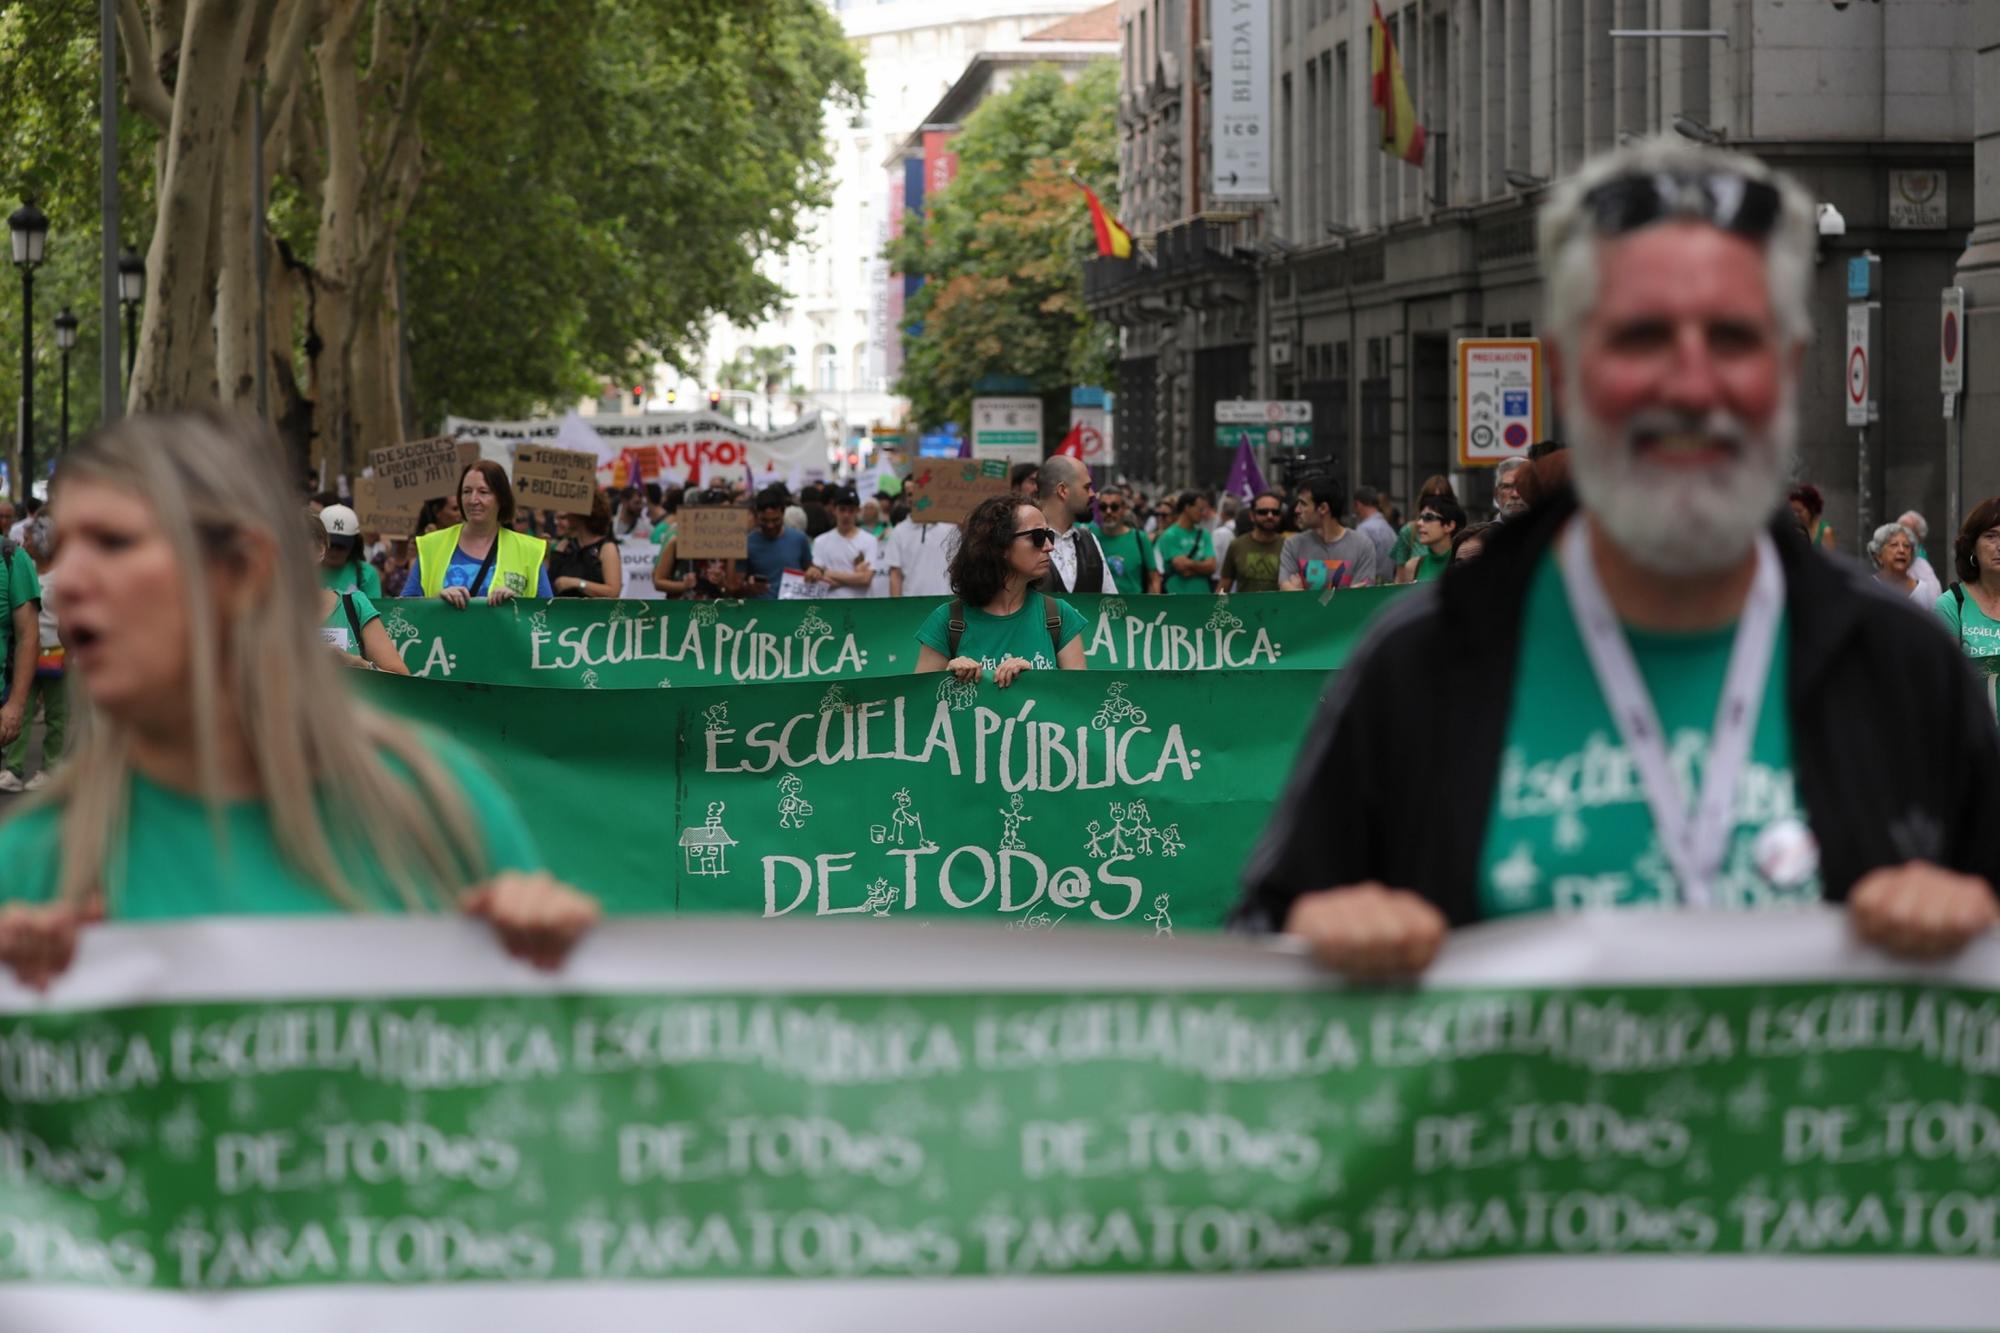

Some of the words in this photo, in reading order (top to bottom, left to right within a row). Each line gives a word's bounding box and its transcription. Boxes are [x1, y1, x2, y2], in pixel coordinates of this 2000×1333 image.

[1230, 22, 1252, 103] BLEDA
[376, 438, 455, 464] DESDOBLES
[379, 450, 457, 477] LABORATORIO
[394, 472, 418, 490] BIO
[531, 615, 705, 670] ESCUELA
[715, 618, 868, 681] PÚBLICA:
[1126, 611, 1282, 671] PÚBLICA:
[704, 696, 962, 775] ESCUELA
[974, 699, 1201, 793] PÚBLICA:
[760, 850, 872, 918] DE
[886, 844, 1143, 920] TOD@S
